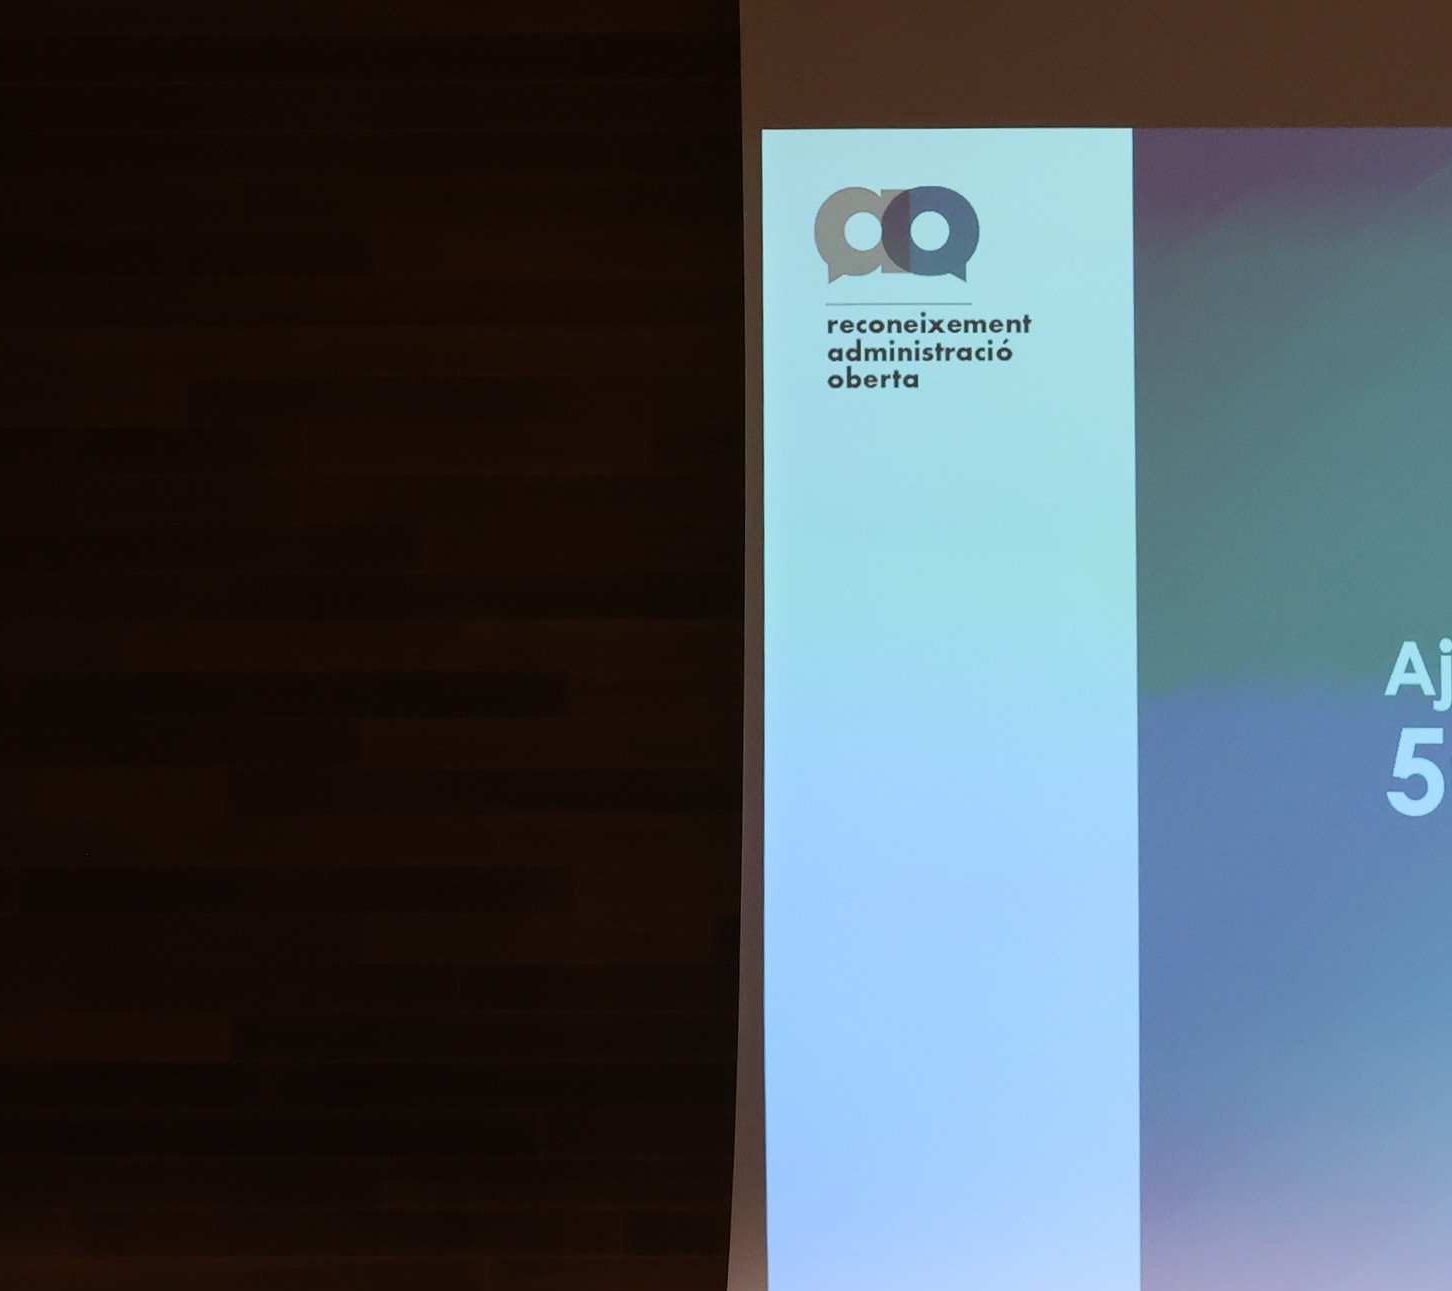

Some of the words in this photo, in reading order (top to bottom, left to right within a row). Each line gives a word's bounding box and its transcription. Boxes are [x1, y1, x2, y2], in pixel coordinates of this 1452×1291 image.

[827, 312, 1032, 334] reconeixement
[827, 338, 1013, 362] administració
[827, 366, 919, 389] oberta
